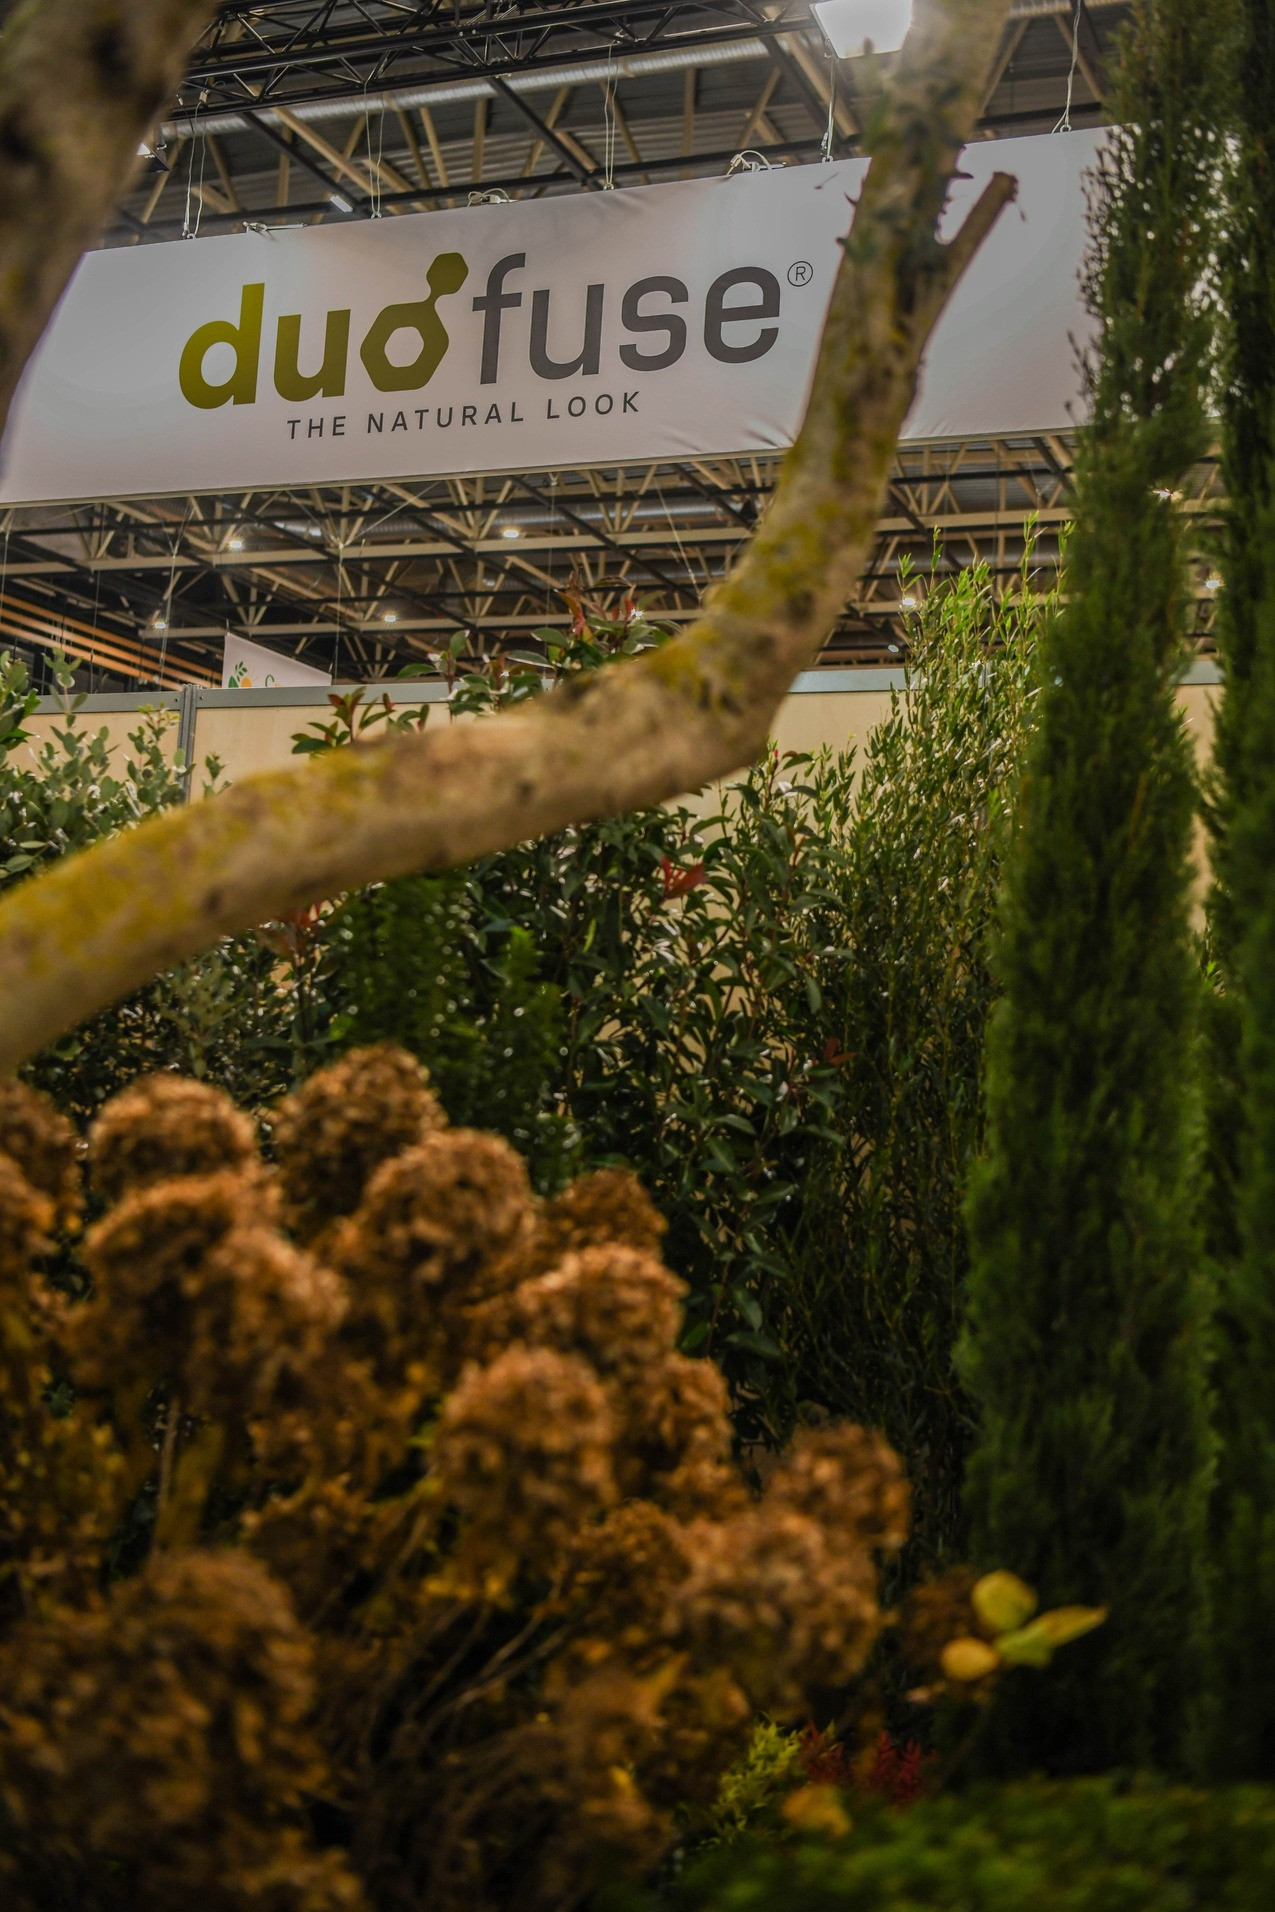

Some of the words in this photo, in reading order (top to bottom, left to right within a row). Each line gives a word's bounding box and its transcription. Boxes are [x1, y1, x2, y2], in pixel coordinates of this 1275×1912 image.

[286, 416, 346, 440] THE
[367, 402, 524, 434] NATURAL
[546, 391, 641, 420] LOOK
